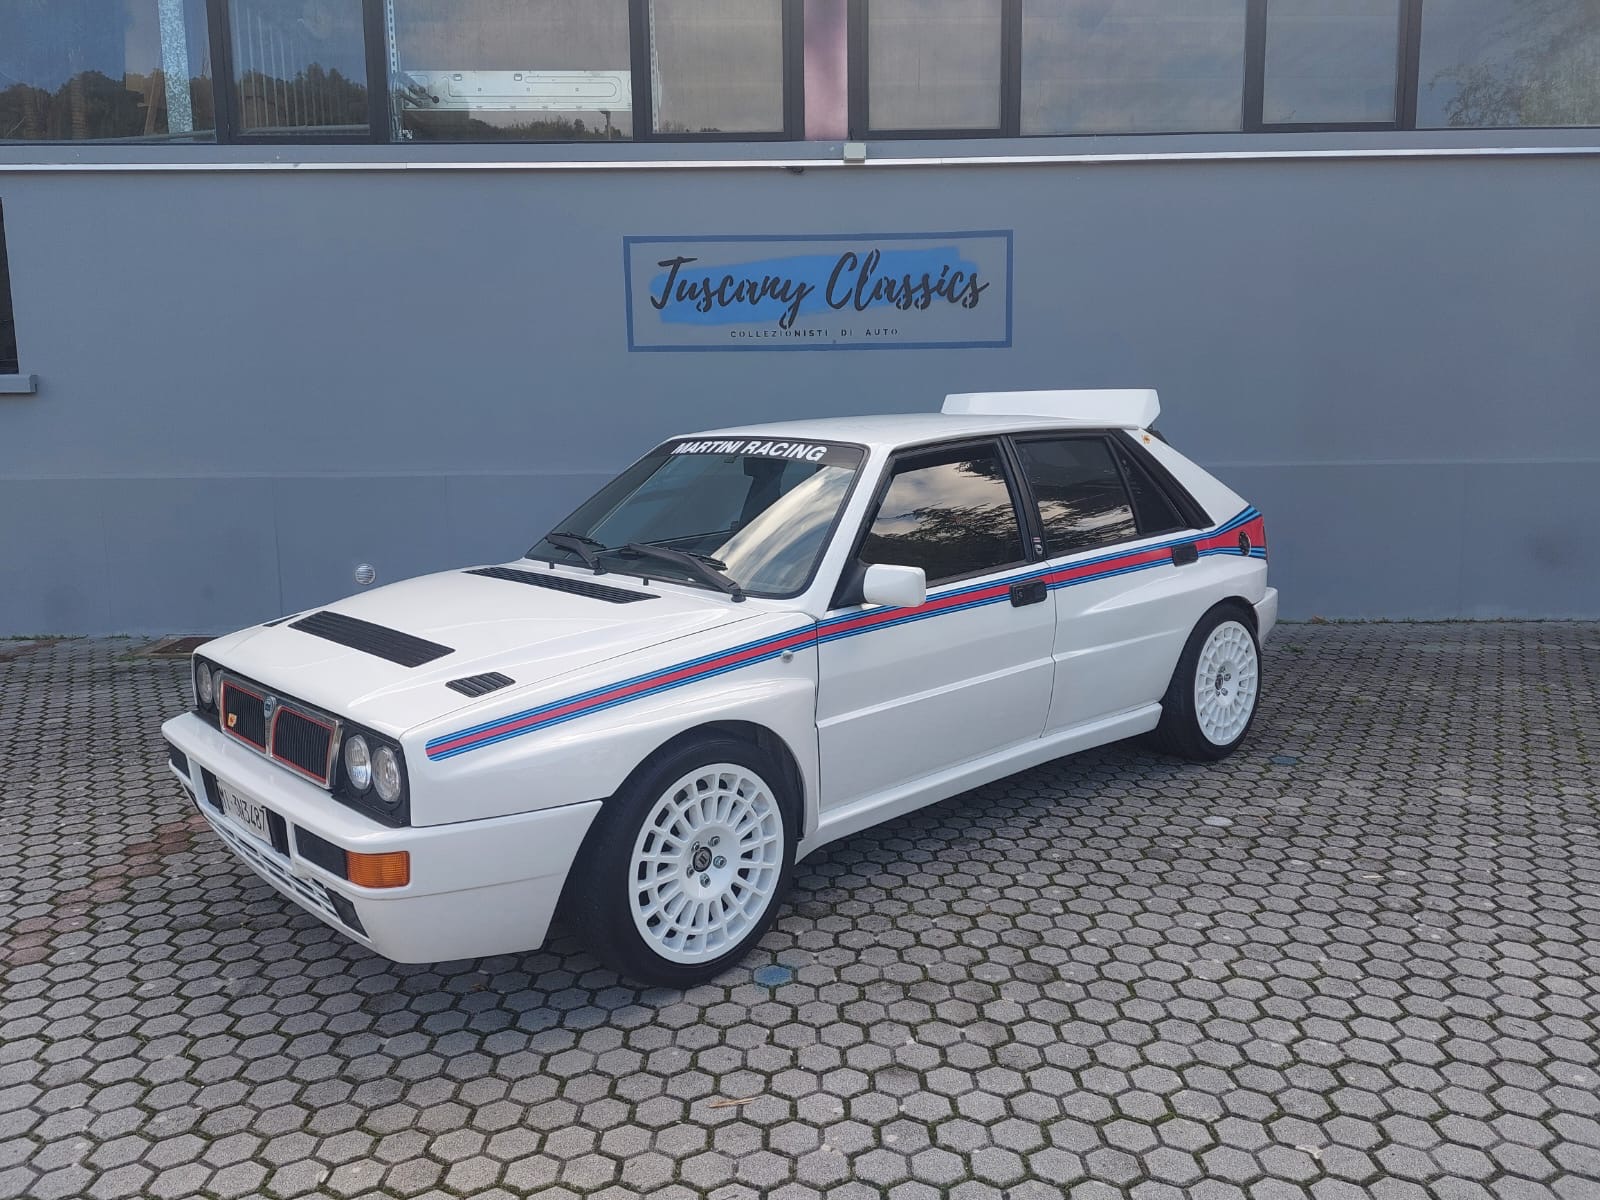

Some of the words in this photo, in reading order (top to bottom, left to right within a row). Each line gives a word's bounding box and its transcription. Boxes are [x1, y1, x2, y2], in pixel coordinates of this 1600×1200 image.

[651, 256, 815, 330] Tuscany
[825, 248, 990, 311] Classics
[730, 329, 828, 338] COLLEZIONISTI
[841, 329, 853, 337] DI
[865, 328, 898, 337] AUTO
[670, 440, 745, 455] MARTINI
[740, 440, 828, 461] RACING
